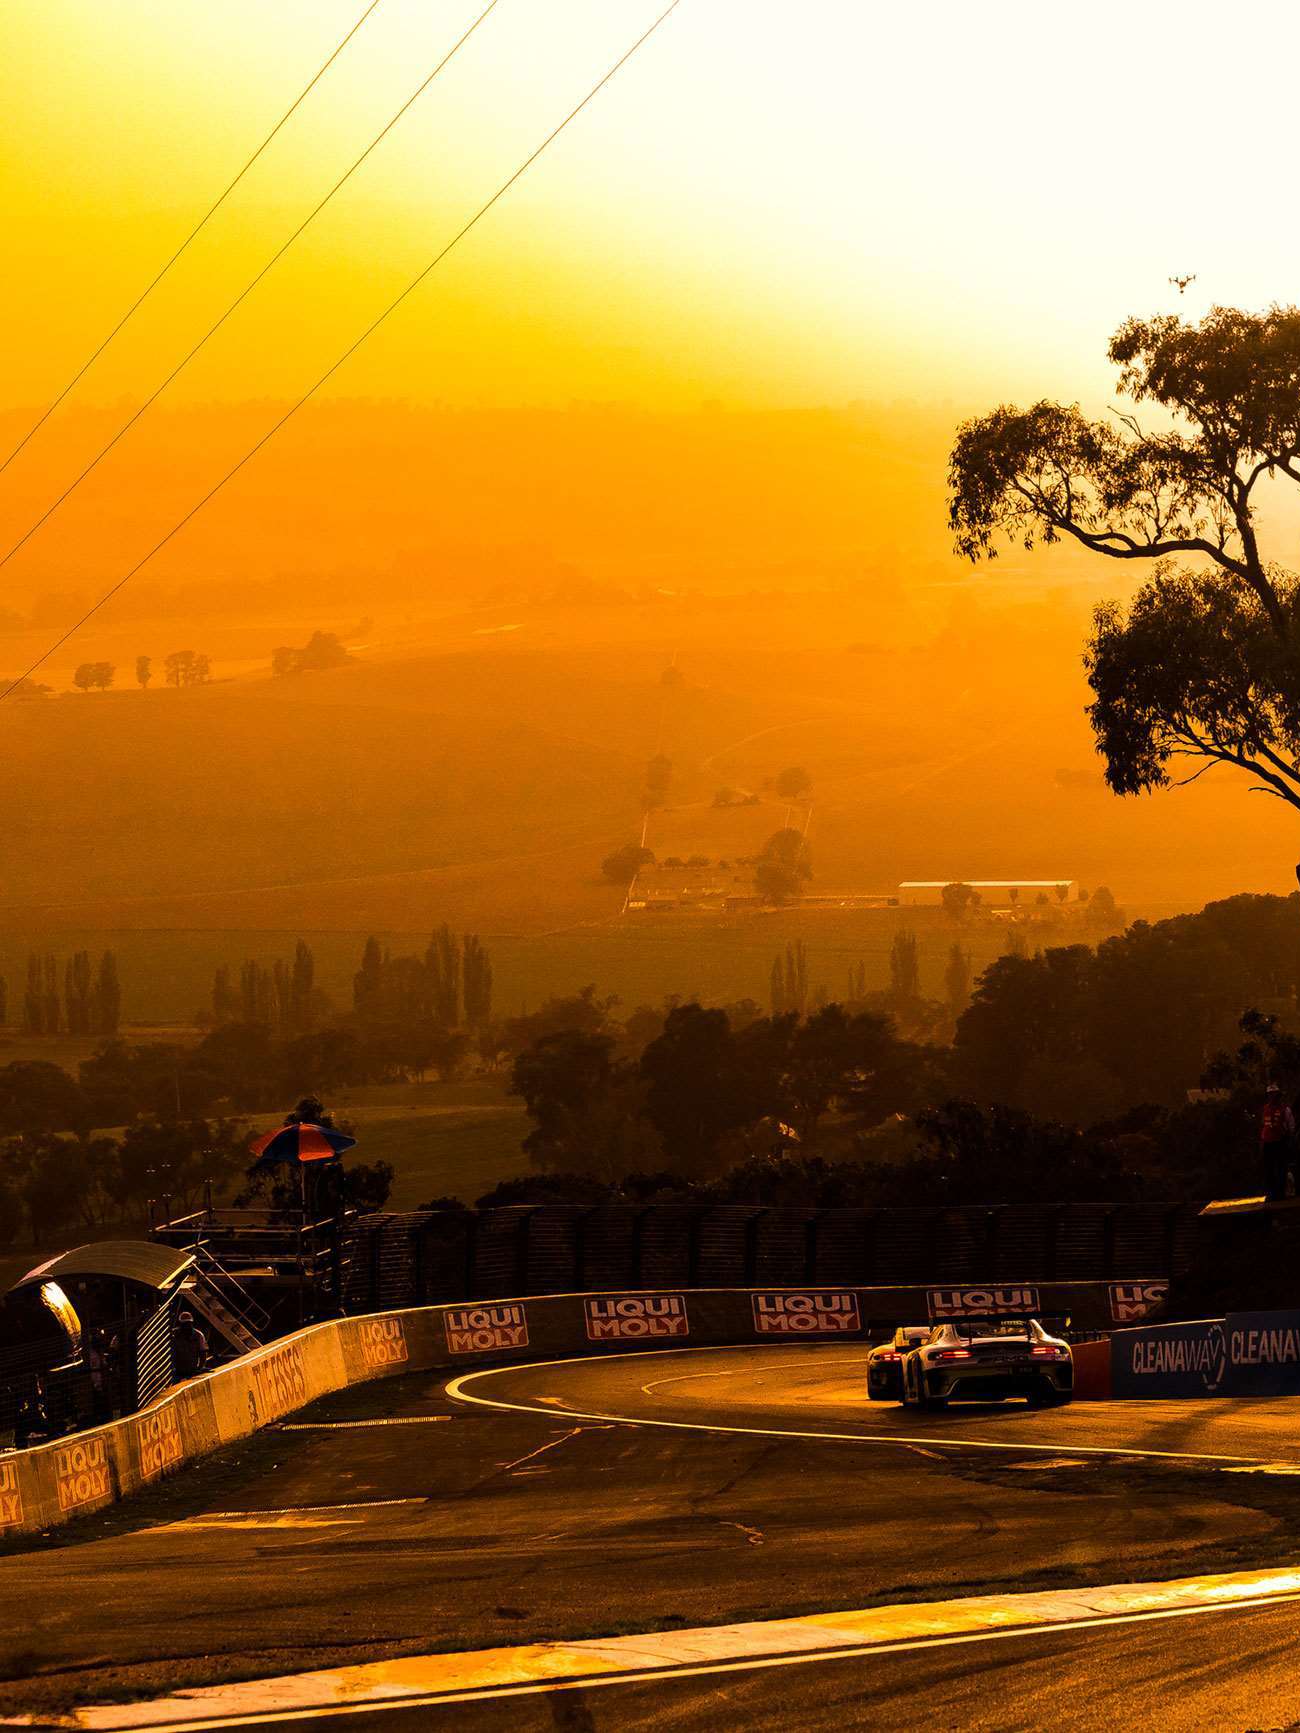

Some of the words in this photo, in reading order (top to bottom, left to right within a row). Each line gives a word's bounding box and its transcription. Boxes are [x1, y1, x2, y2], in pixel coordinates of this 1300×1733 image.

[758, 1295, 851, 1313] LIQUI
[933, 1289, 1033, 1308] LIQUI
[1115, 1286, 1168, 1303] LIQ
[448, 1306, 521, 1331] LIQUI
[590, 1298, 681, 1318] LIQUI
[360, 1320, 401, 1342] LIQUI
[592, 1317, 684, 1337] MOLY
[760, 1312, 856, 1331] MOLY
[451, 1326, 524, 1351] MOLY
[362, 1340, 405, 1366] MOLY
[1133, 1339, 1220, 1374] CLEANAWAY
[270, 1343, 306, 1411] ESSES
[138, 1407, 177, 1444] LIQUI
[58, 1437, 106, 1477] LIQUI
[141, 1432, 181, 1476] MOLY
[60, 1466, 109, 1511] MOLY
